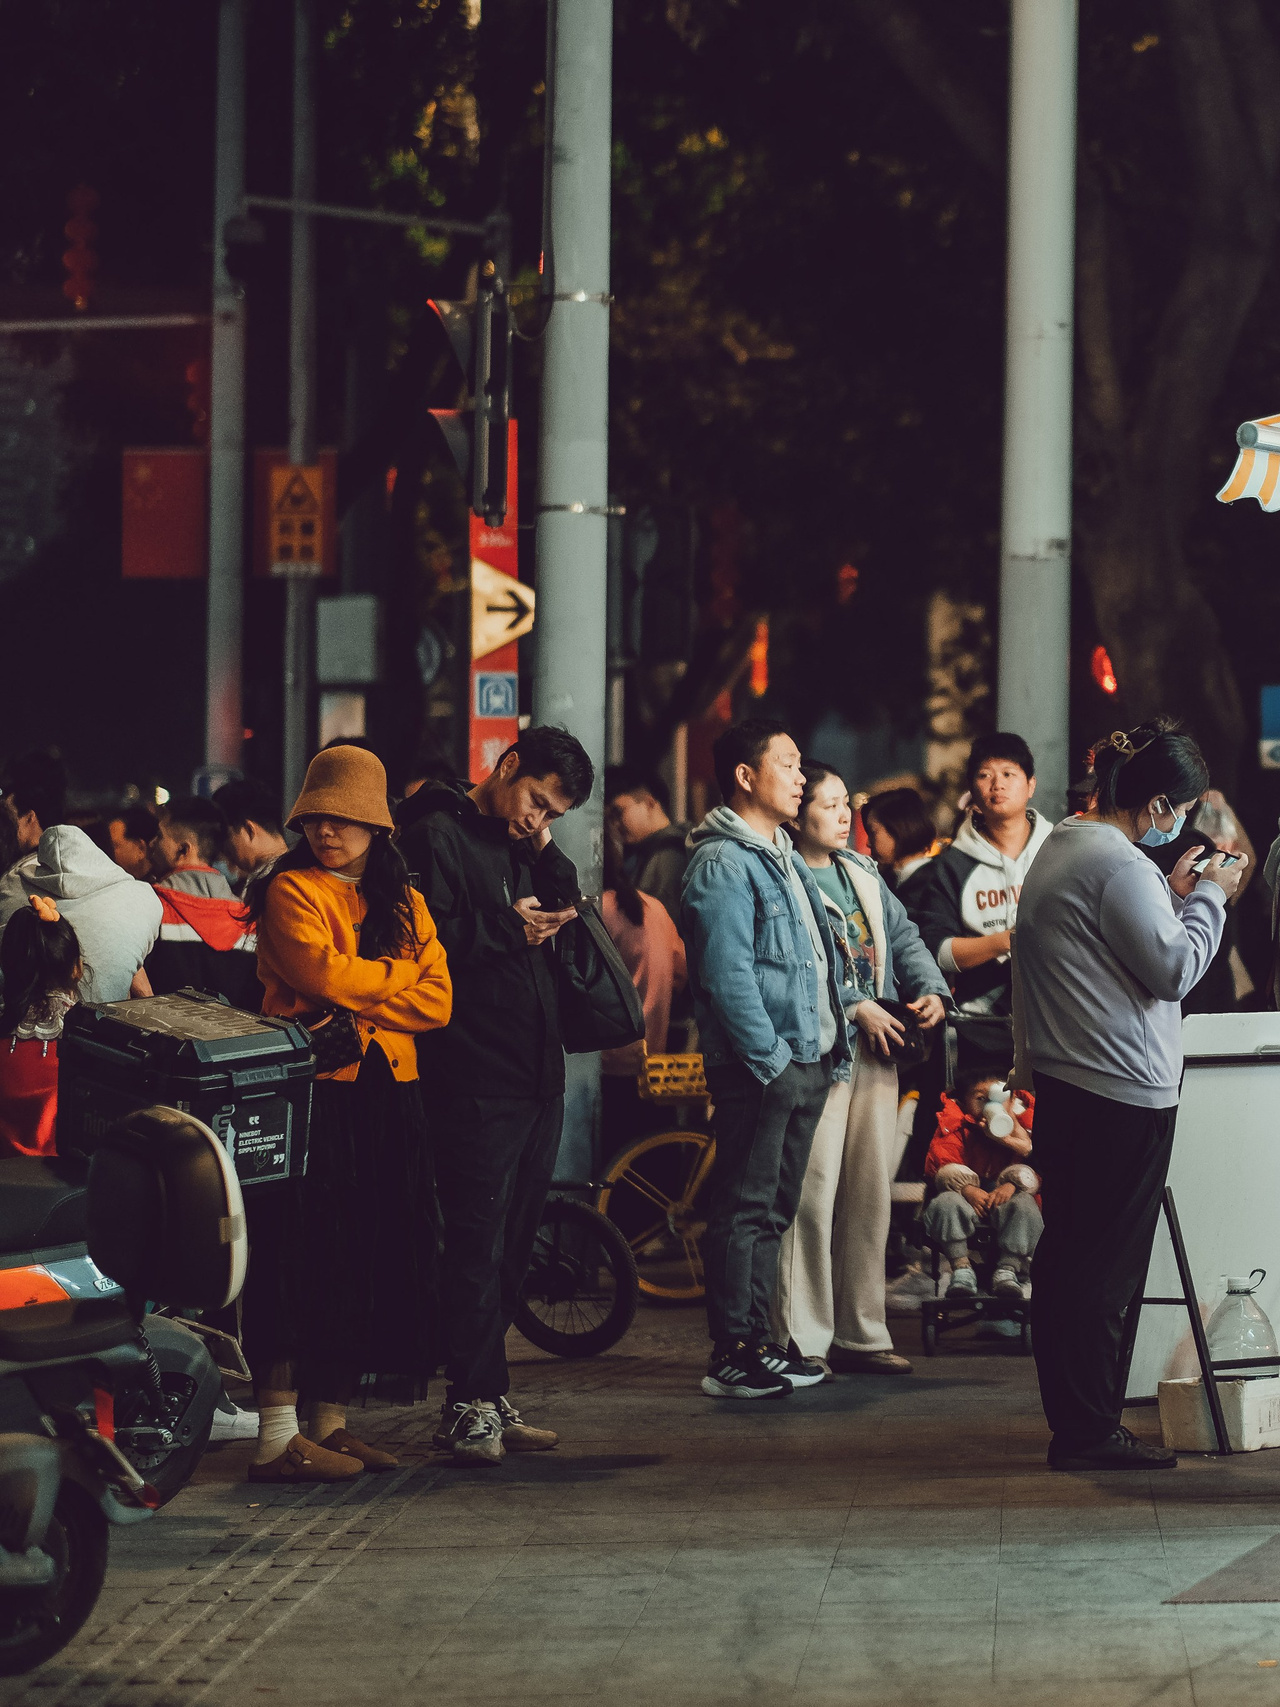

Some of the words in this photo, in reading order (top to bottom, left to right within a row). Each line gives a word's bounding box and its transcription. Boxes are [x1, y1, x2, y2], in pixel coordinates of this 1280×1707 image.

[239, 1130, 261, 1138] NINEBOT
[239, 1137, 263, 1146] ELECTRIC
[263, 1134, 284, 1143] VEHICLE
[238, 1146, 256, 1155] SIMPLY
[256, 1143, 276, 1151] MOVING
